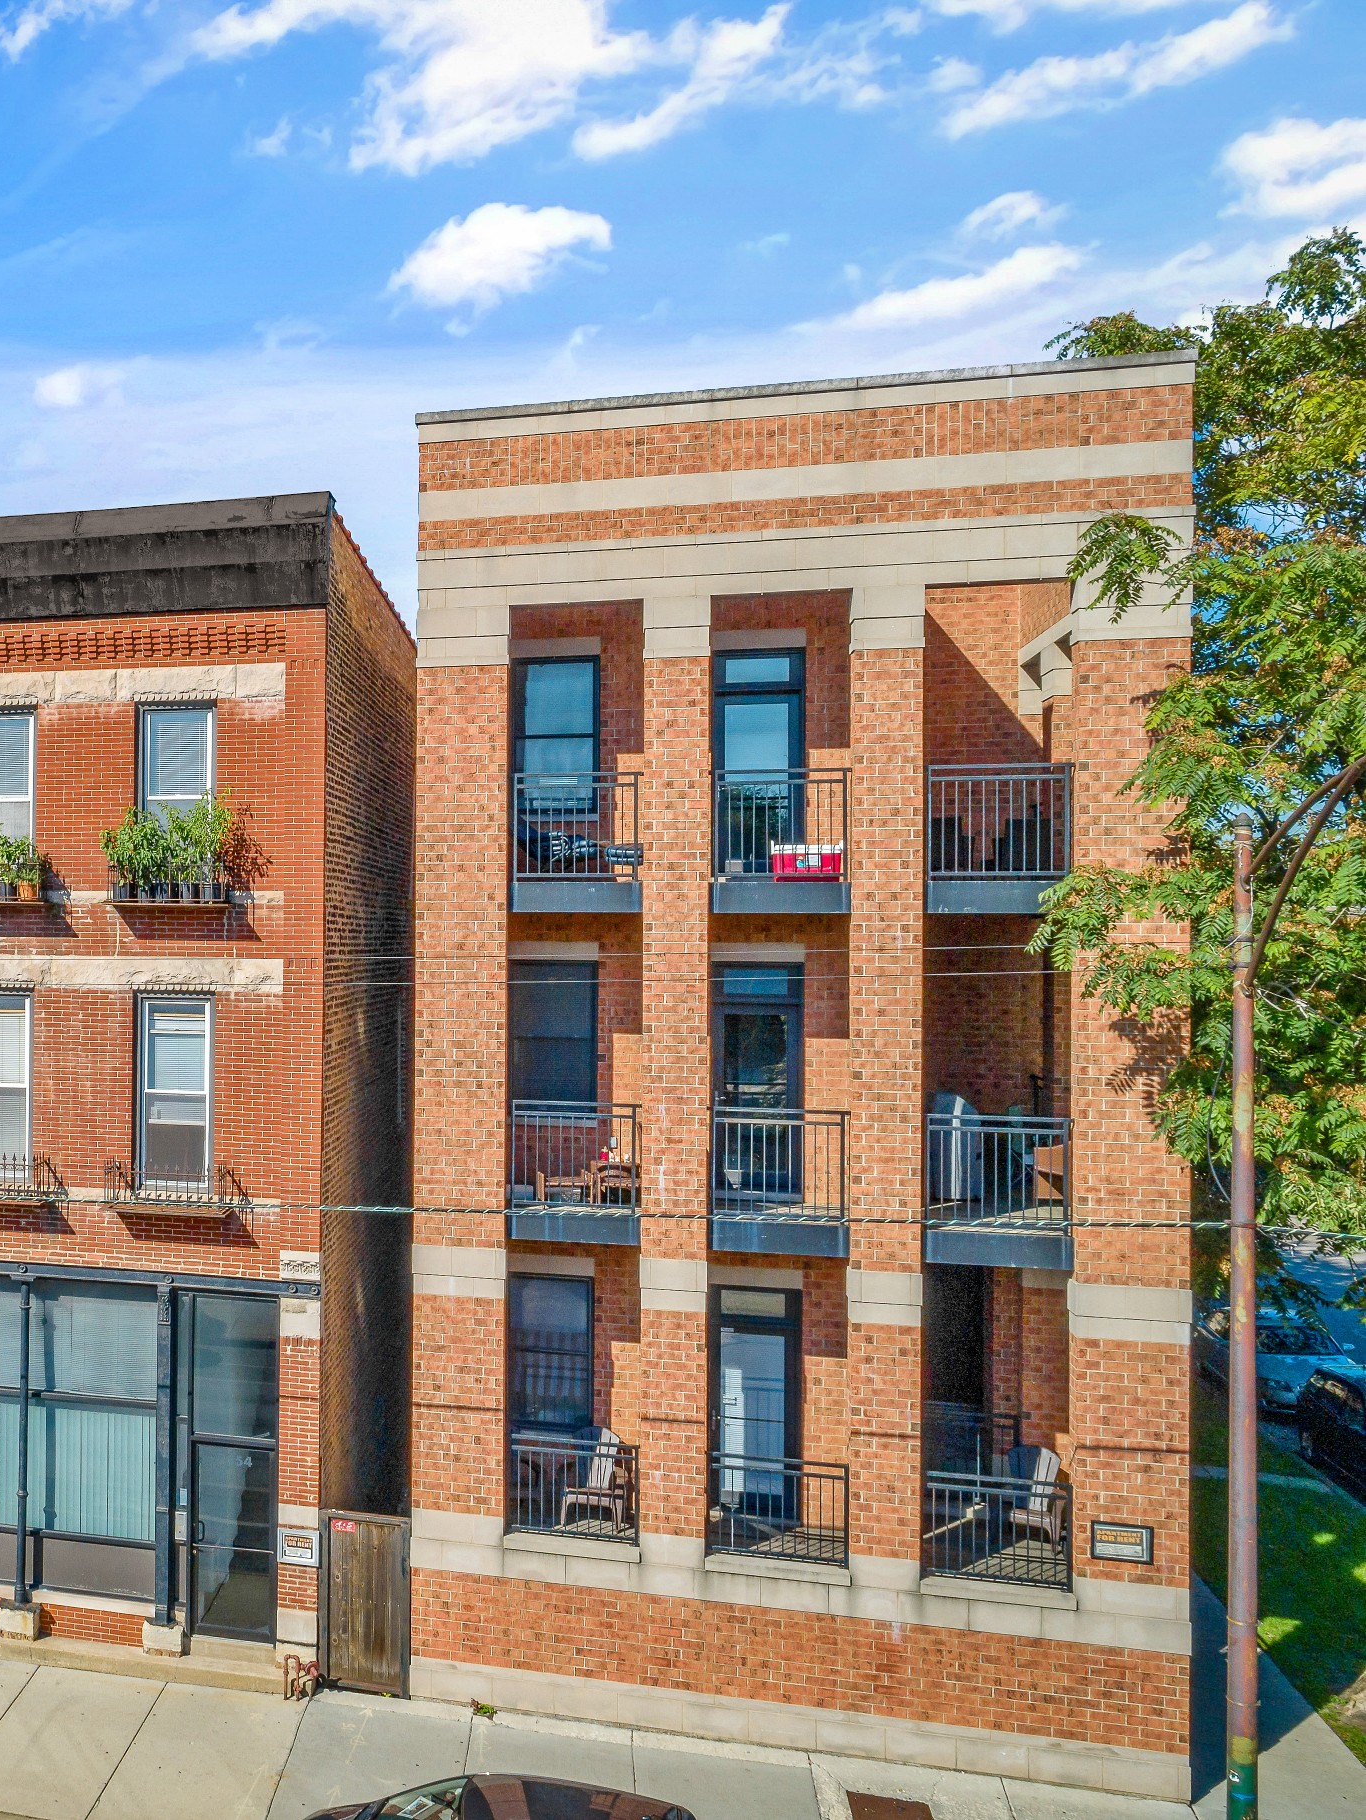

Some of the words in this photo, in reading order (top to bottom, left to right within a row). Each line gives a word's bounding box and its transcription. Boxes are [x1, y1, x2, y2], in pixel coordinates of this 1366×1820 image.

[1096, 1534, 1115, 1542] FOR
[1116, 1536, 1142, 1544] RENT
[297, 1541, 312, 1549] RENT
